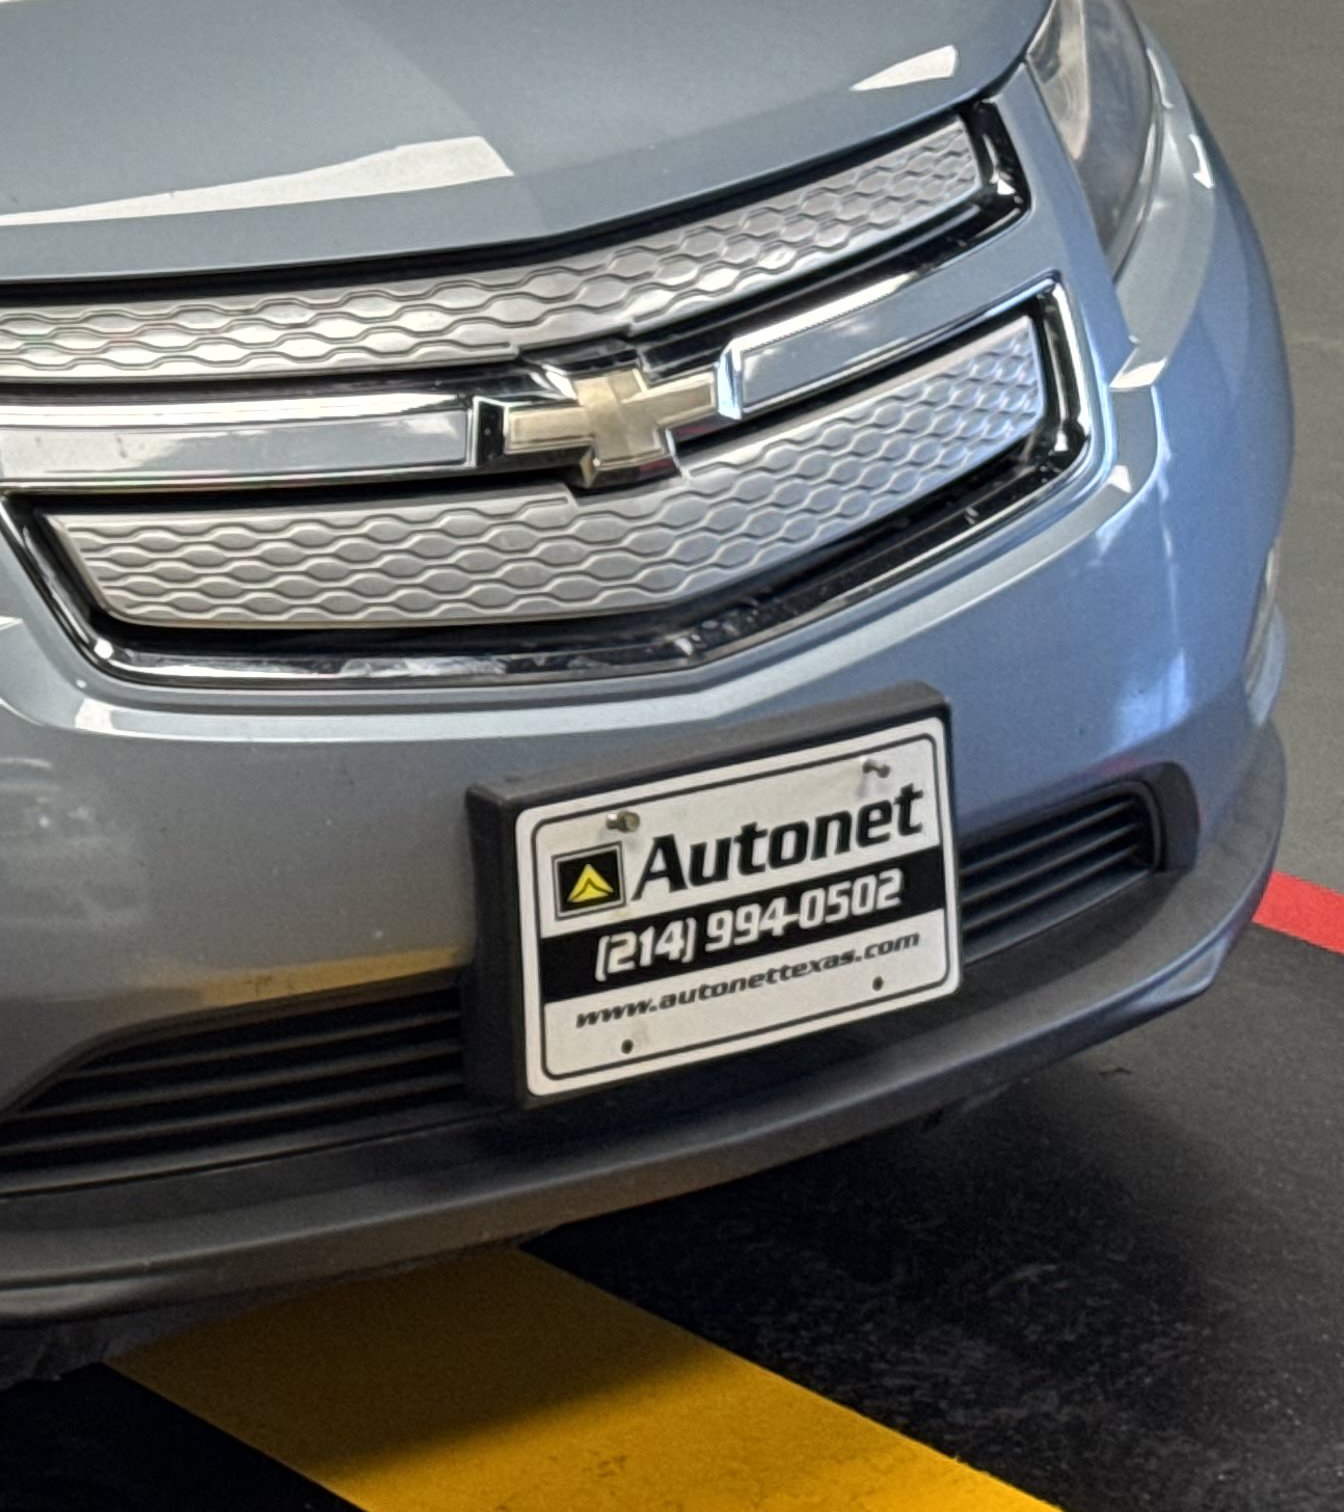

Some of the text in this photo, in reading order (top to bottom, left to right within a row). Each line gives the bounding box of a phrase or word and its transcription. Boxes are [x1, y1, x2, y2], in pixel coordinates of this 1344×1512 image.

[631, 783, 924, 901] Autonet
[576, 933, 920, 1028] www.autonettexas.com
[595, 868, 904, 982] (214) 994-0502
